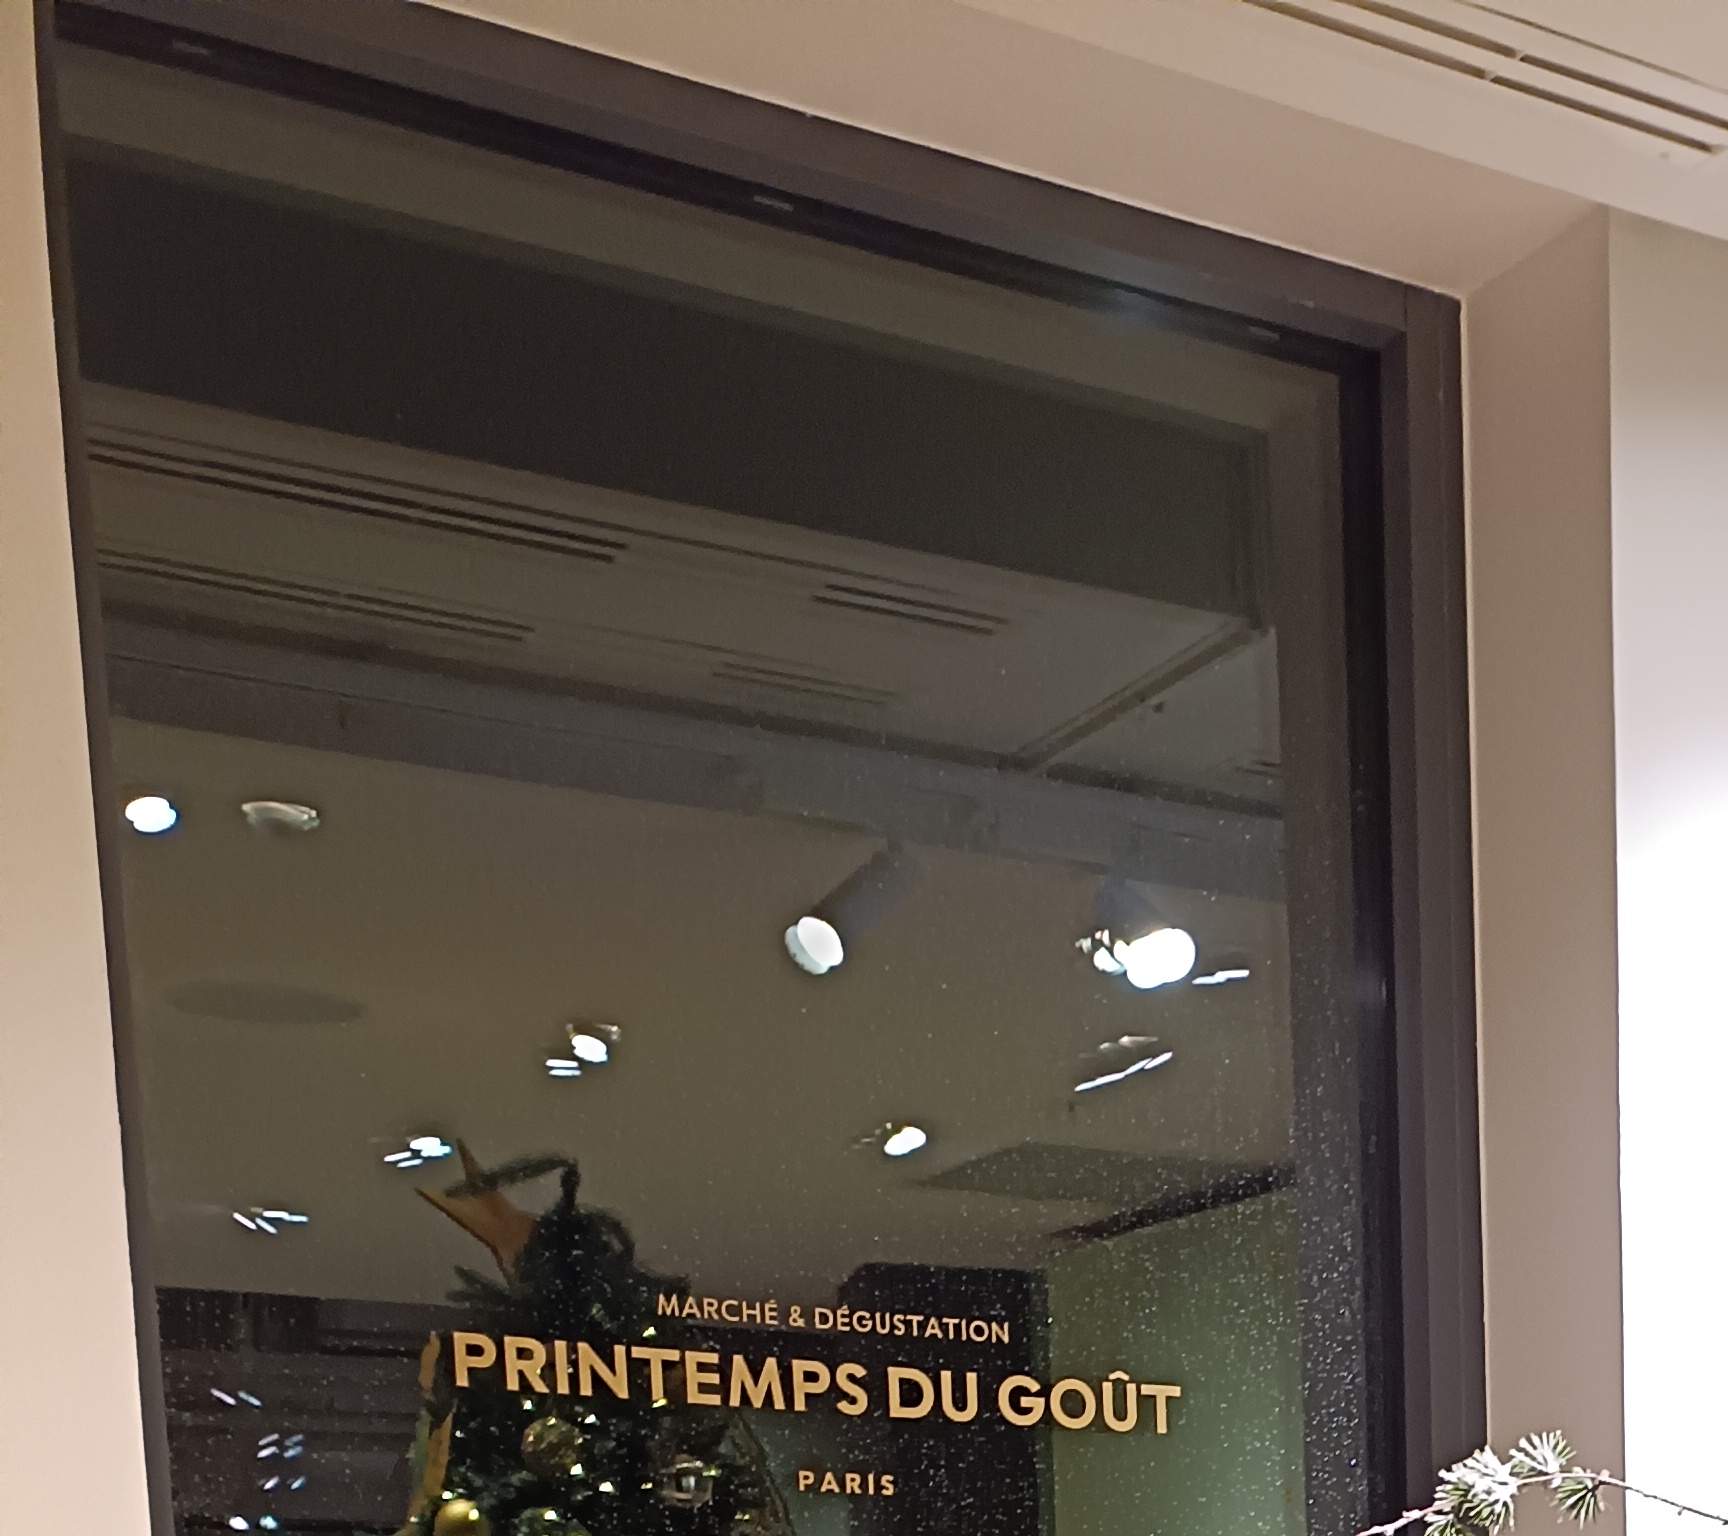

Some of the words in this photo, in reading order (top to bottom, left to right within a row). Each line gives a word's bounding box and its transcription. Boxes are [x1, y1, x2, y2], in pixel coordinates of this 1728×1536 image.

[656, 1293, 779, 1325] MARCHÉ
[788, 1305, 806, 1328] &
[814, 1305, 1010, 1344] DÉGUSTATION
[453, 1331, 869, 1416] PRINTEMPS
[887, 1366, 979, 1422] DU
[998, 1370, 1182, 1434] GOÛT
[798, 1470, 895, 1496] PARIS
